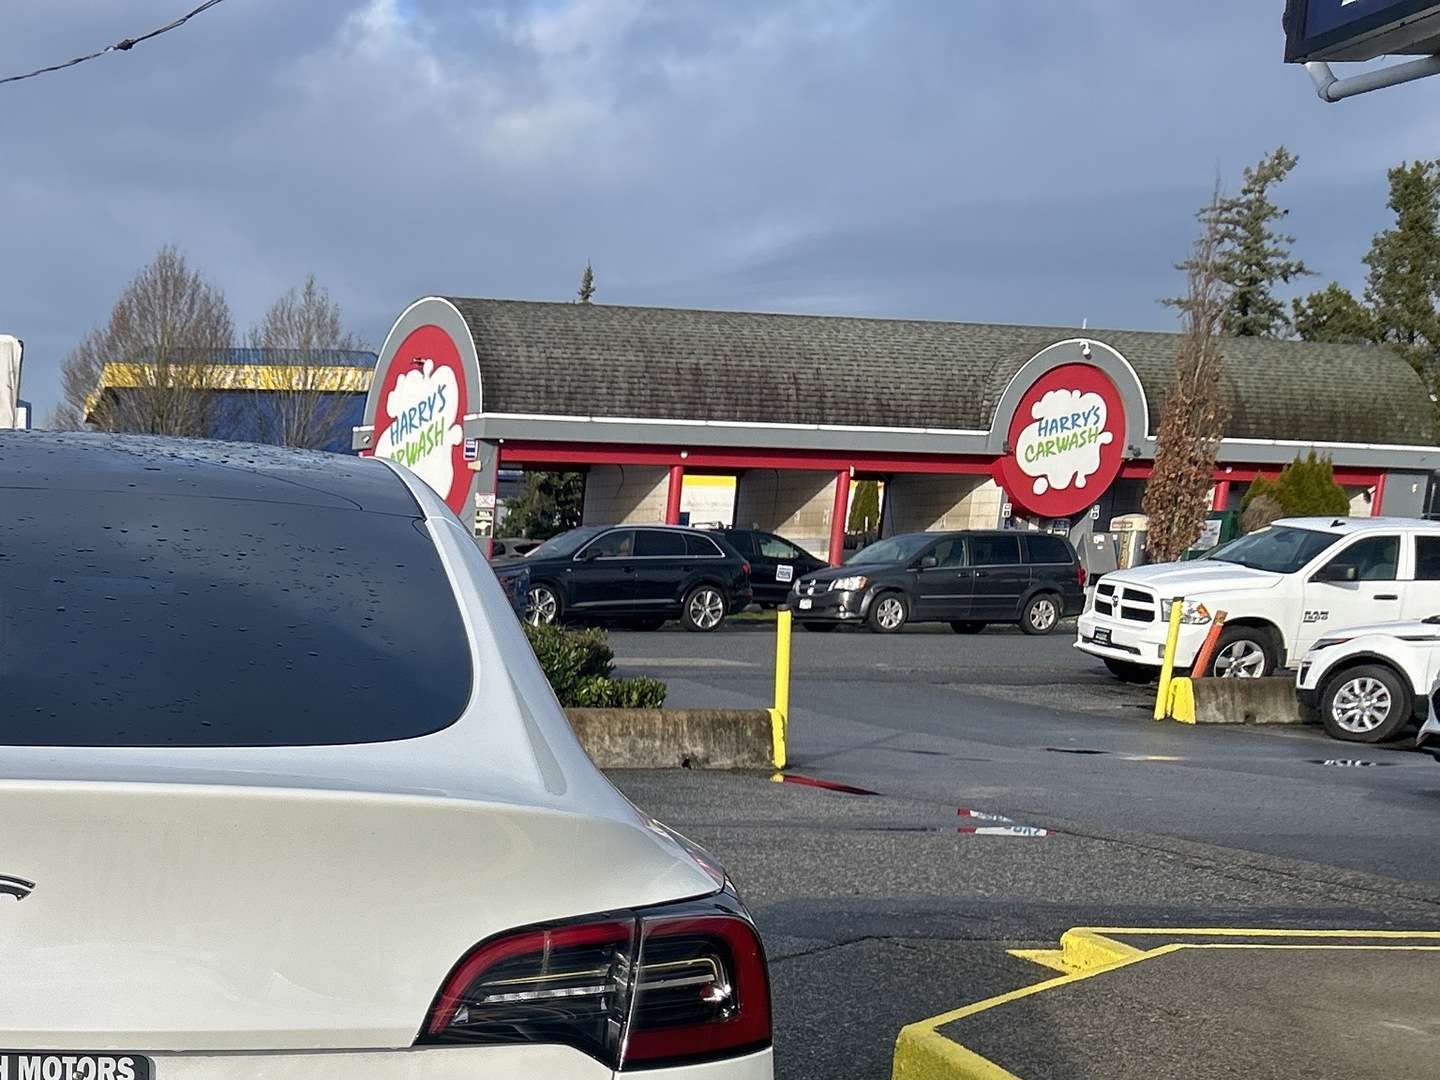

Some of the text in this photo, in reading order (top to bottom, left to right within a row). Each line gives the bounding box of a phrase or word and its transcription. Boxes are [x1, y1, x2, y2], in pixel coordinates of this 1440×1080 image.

[390, 384, 447, 446] HARRY'S
[1038, 405, 1100, 437] HARRY'S
[1024, 426, 1099, 463] CARWASH
